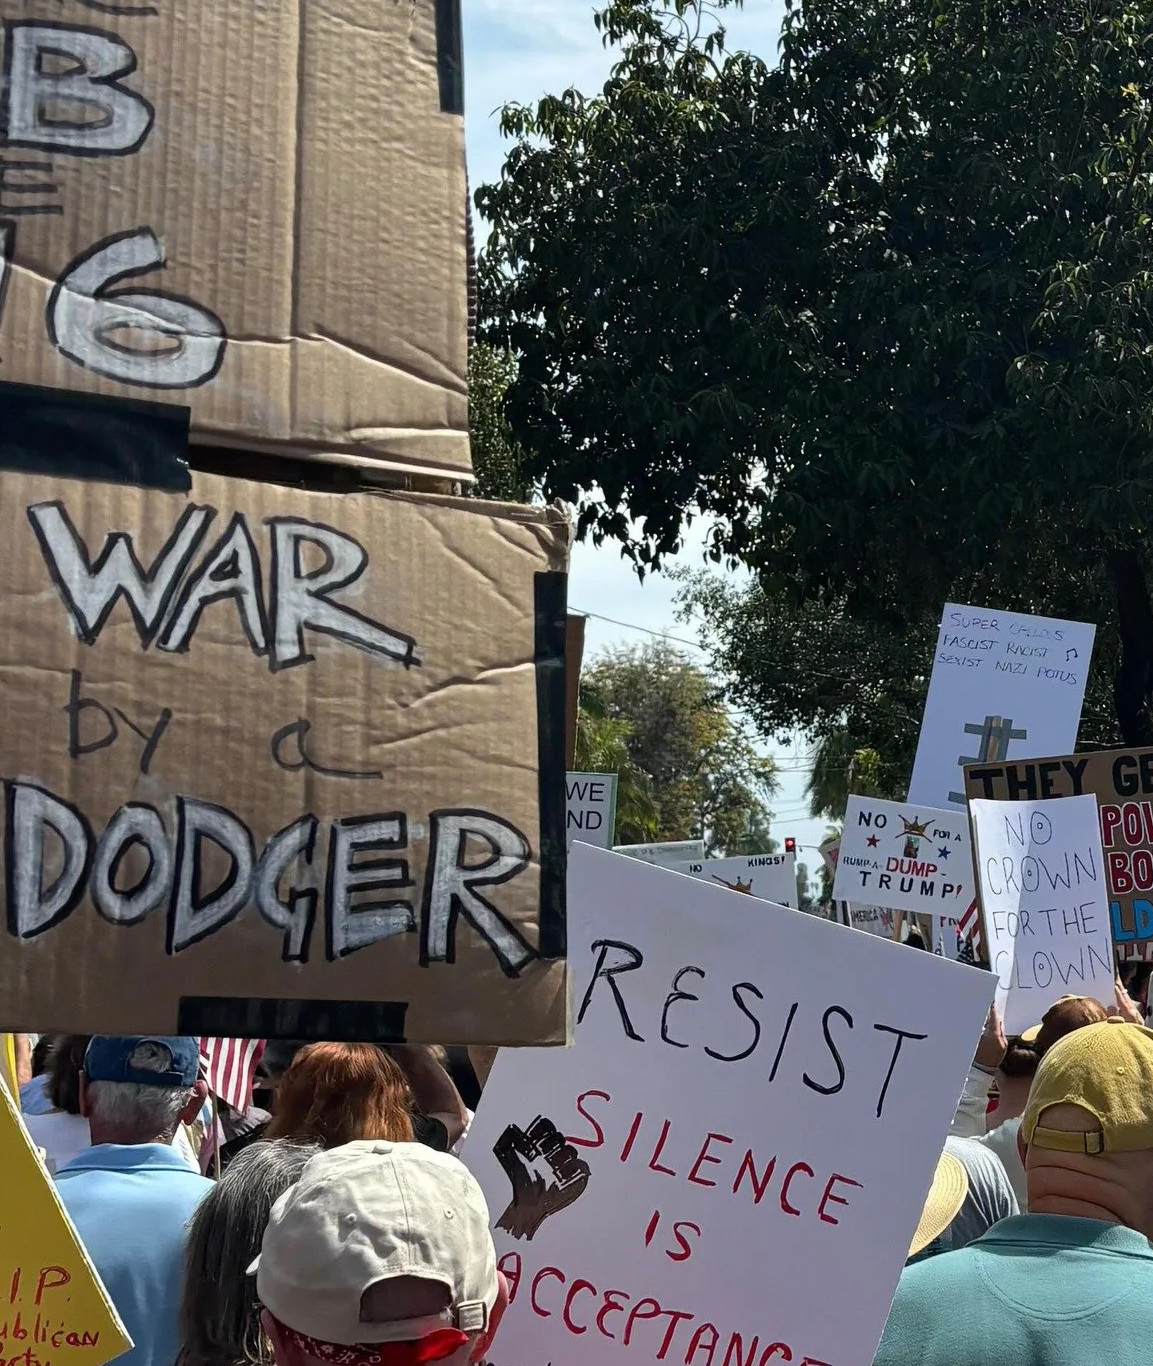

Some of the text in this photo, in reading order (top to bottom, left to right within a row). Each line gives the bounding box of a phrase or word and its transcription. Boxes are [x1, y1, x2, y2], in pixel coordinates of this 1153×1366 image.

[26, 500, 422, 673] WAR
[951, 612, 1000, 631] SUPER
[943, 634, 1049, 658] FASCIST RACIST
[937, 652, 1078, 685] SEXIST NAZI POTUS
[65, 668, 383, 779] by a
[969, 758, 1089, 801] THEY
[858, 810, 962, 842] NO FOR A
[1005, 811, 1052, 846] NO
[2, 777, 540, 978] DODGER
[689, 855, 785, 874] NO KINGS!
[859, 870, 963, 899] TRUMP!
[987, 847, 1098, 896] CROWN
[992, 901, 1098, 940] FOR THE
[995, 937, 1112, 991] CLOWN
[577, 939, 928, 1118] RESIST
[565, 1090, 864, 1225] SILENCE
[645, 1210, 702, 1262] IS
